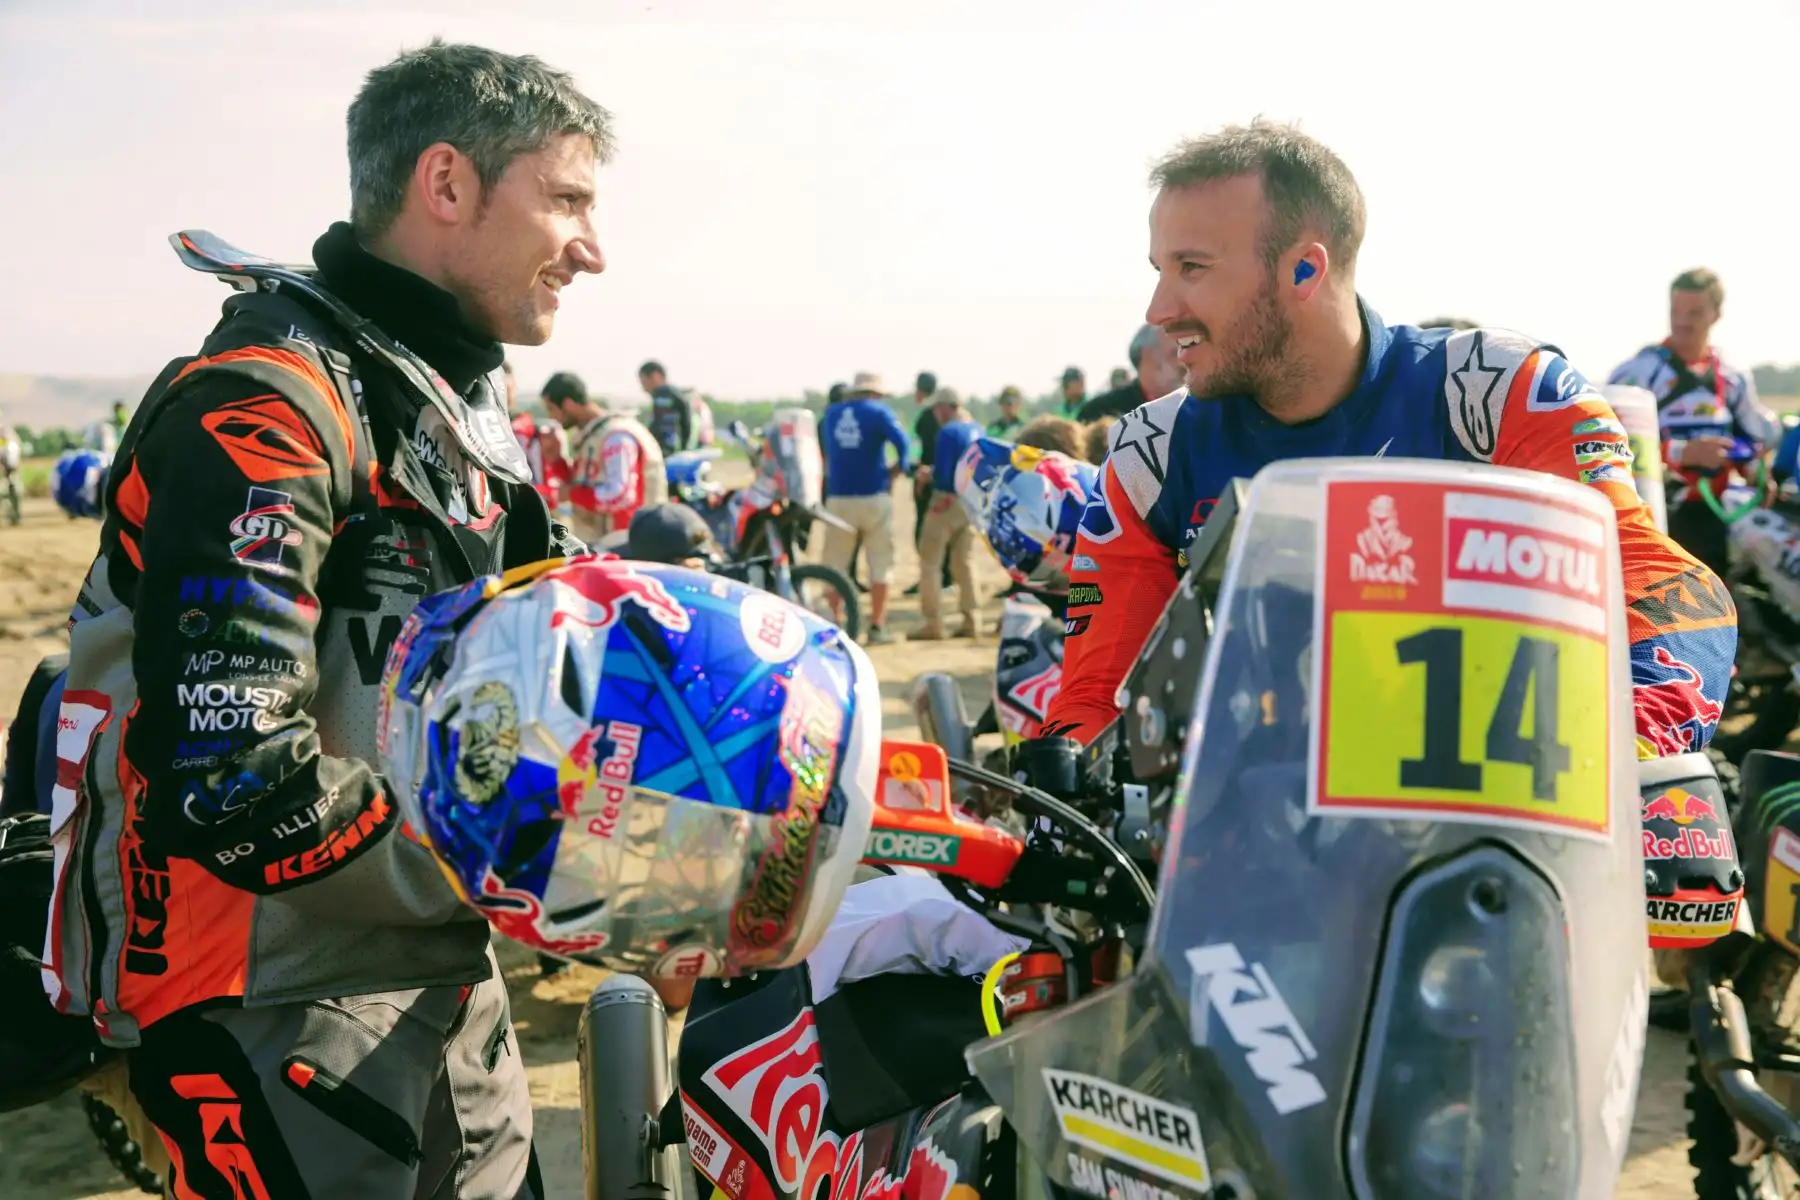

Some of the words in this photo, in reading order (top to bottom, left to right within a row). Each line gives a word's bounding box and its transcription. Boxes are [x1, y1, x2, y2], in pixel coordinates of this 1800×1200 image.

[1457, 527, 1600, 597] MOTUL
[229, 653, 255, 669] MP
[1396, 626, 1571, 803] 14
[601, 721, 640, 782] Bull
[587, 781, 627, 841] Red
[866, 831, 952, 863] TOREX
[1641, 827, 1693, 859] Red
[1691, 828, 1733, 860] Bull
[1646, 902, 1736, 922] ÄRCHER
[1185, 943, 1328, 1115] KTM
[1051, 1077, 1196, 1151] KÄRCHER
